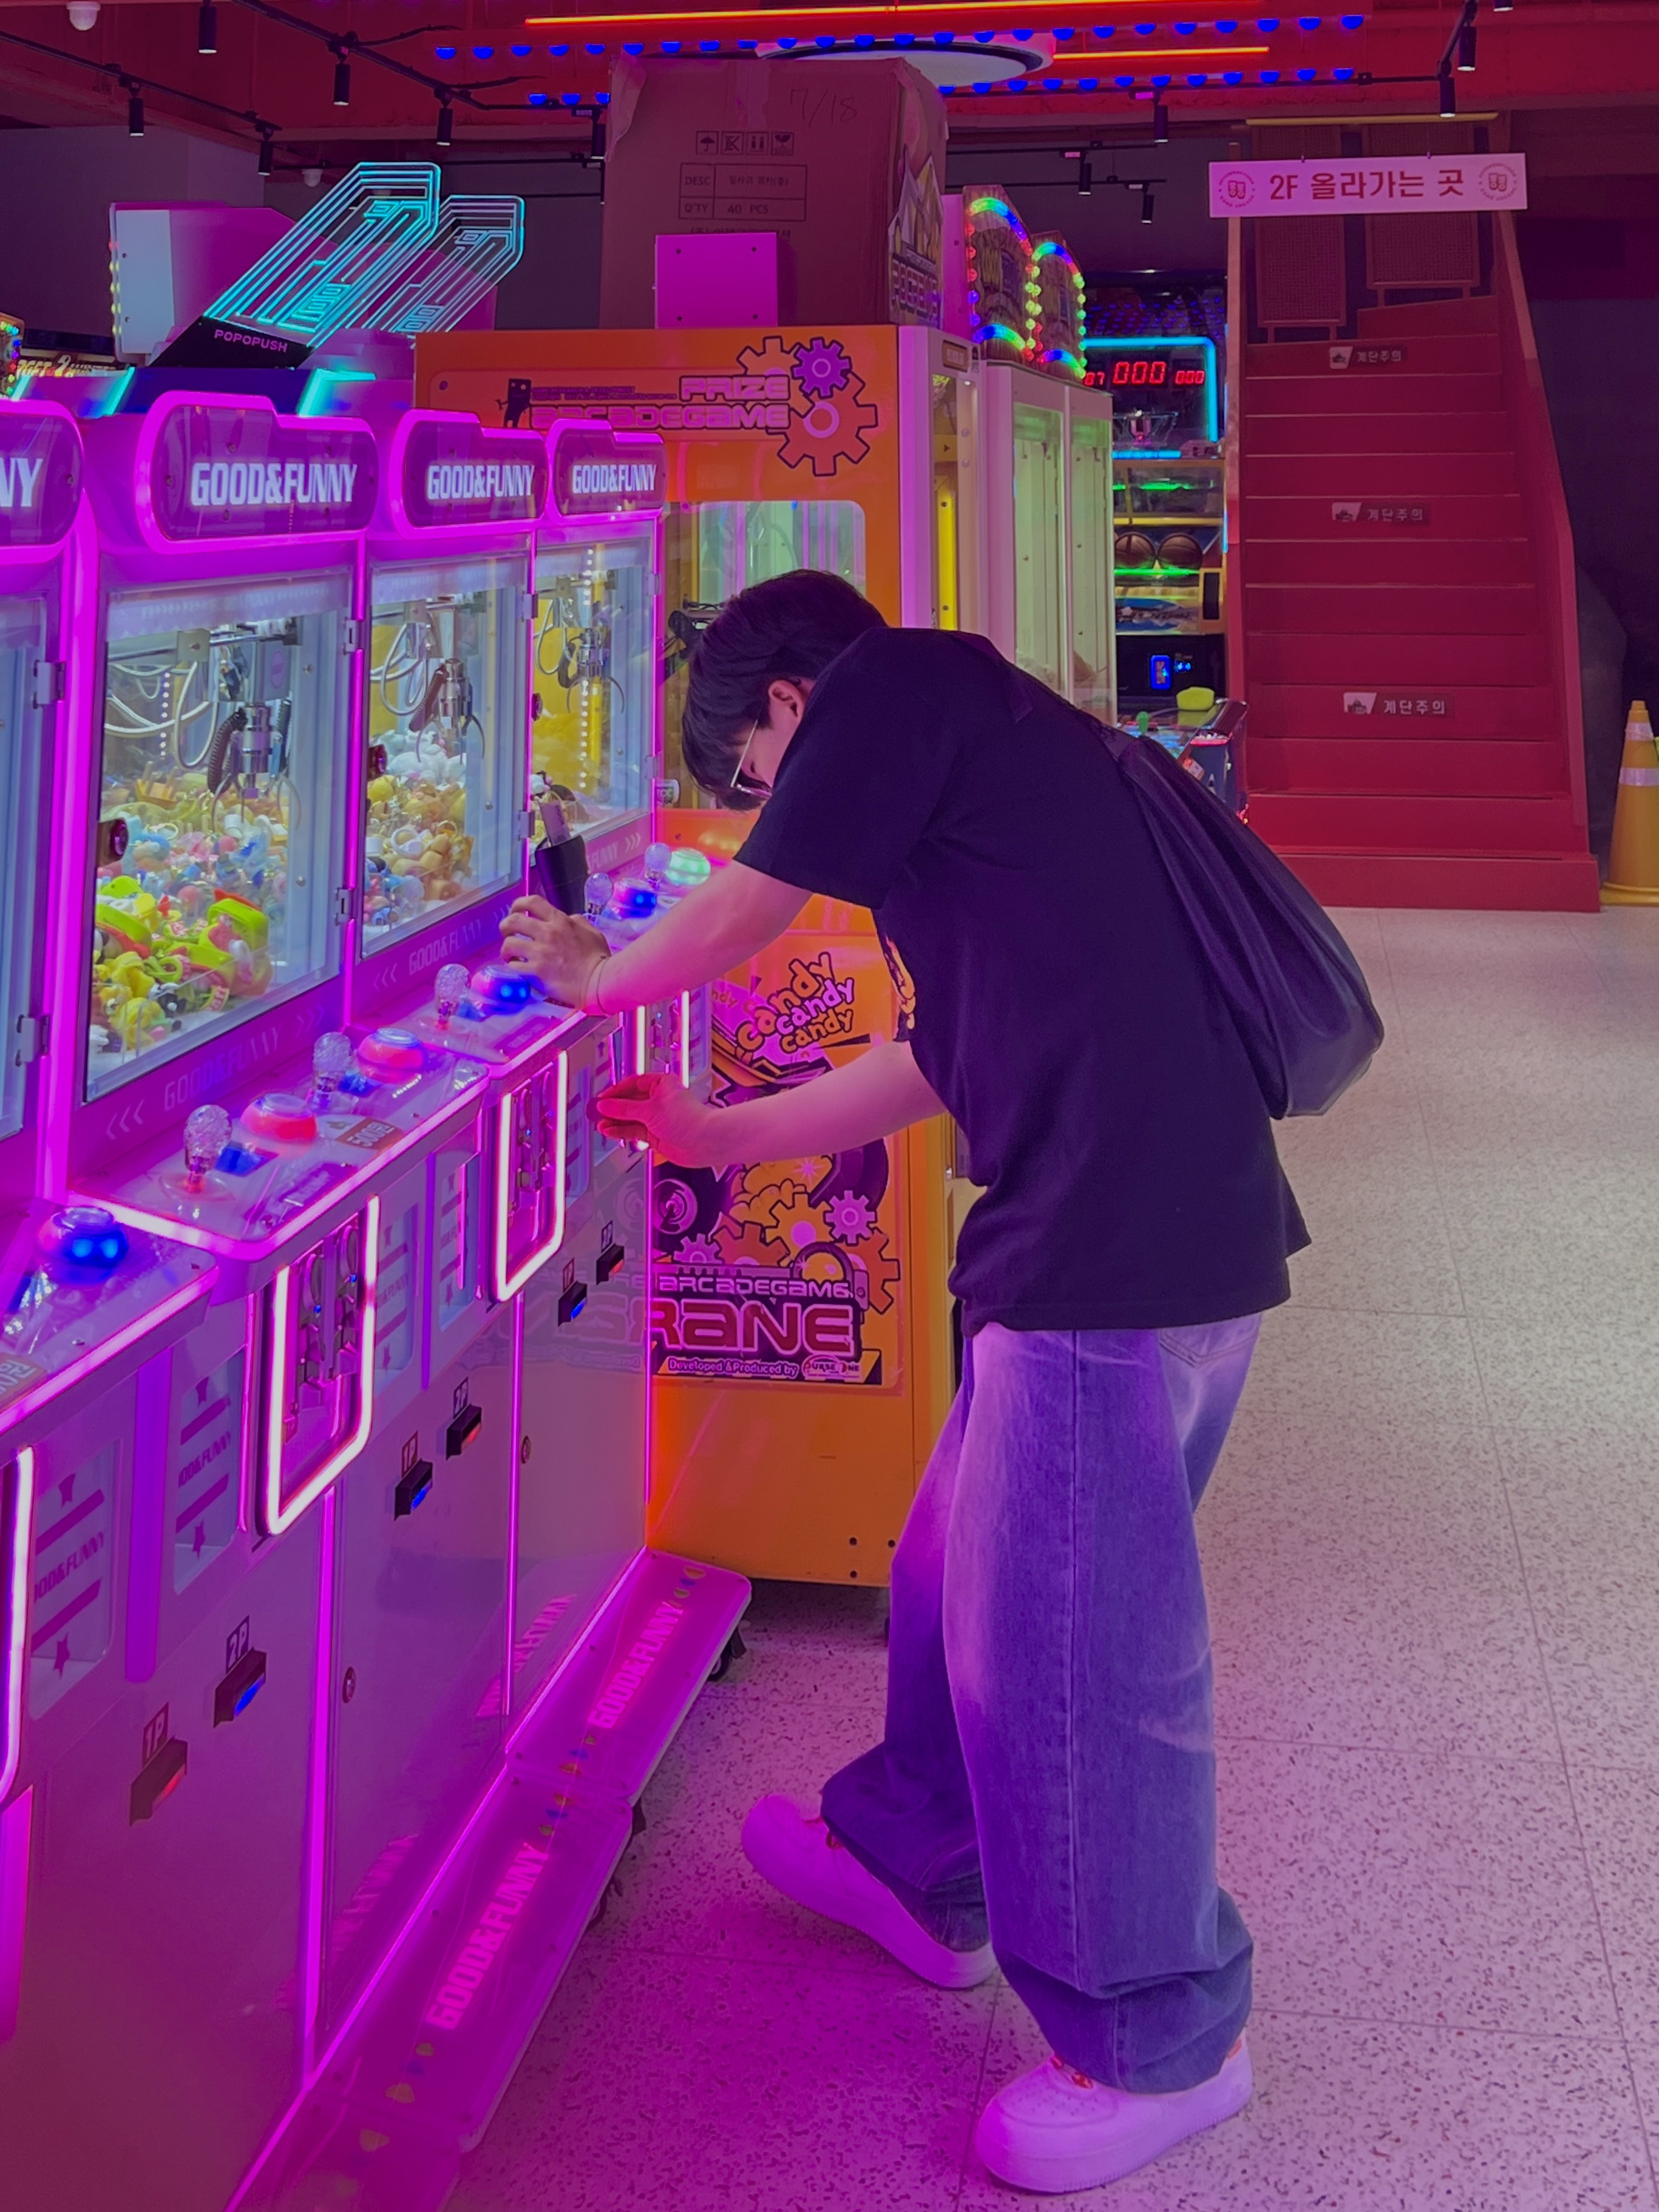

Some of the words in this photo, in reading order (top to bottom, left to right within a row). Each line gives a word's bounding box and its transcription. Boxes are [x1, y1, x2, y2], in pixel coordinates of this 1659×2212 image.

[790, 87, 857, 127] 7/18
[684, 176, 711, 186] DESC
[1269, 174, 1299, 200] 2F
[1311, 171, 1425, 200] 올라가는
[1437, 169, 1464, 197] 곳
[727, 204, 742, 214] 40
[750, 205, 768, 214] PCS
[213, 328, 288, 354] POPOPUSH
[1357, 350, 1402, 363] 계단주의
[1113, 361, 1167, 385] 000
[1175, 370, 1205, 385] 000
[681, 376, 789, 401] PRIZE
[191, 462, 358, 506] GOOD&FUNNY
[427, 464, 535, 500] GOOD&FUNNY
[572, 464, 657, 494] GOOD&FUNNY
[1367, 508, 1423, 522] 계단주의
[1383, 699, 1446, 716] 계단주의
[670, 1360, 722, 1372] Developed
[784, 1363, 796, 1376] by
[453, 1382, 468, 1416] 2P
[402, 1437, 417, 1476] 1P
[228, 1621, 248, 1669] 2P
[588, 1601, 684, 1729] GOOD&FUNNY
[145, 1710, 166, 1759] 1P
[426, 1842, 549, 2030] GOOD&FUNNY
